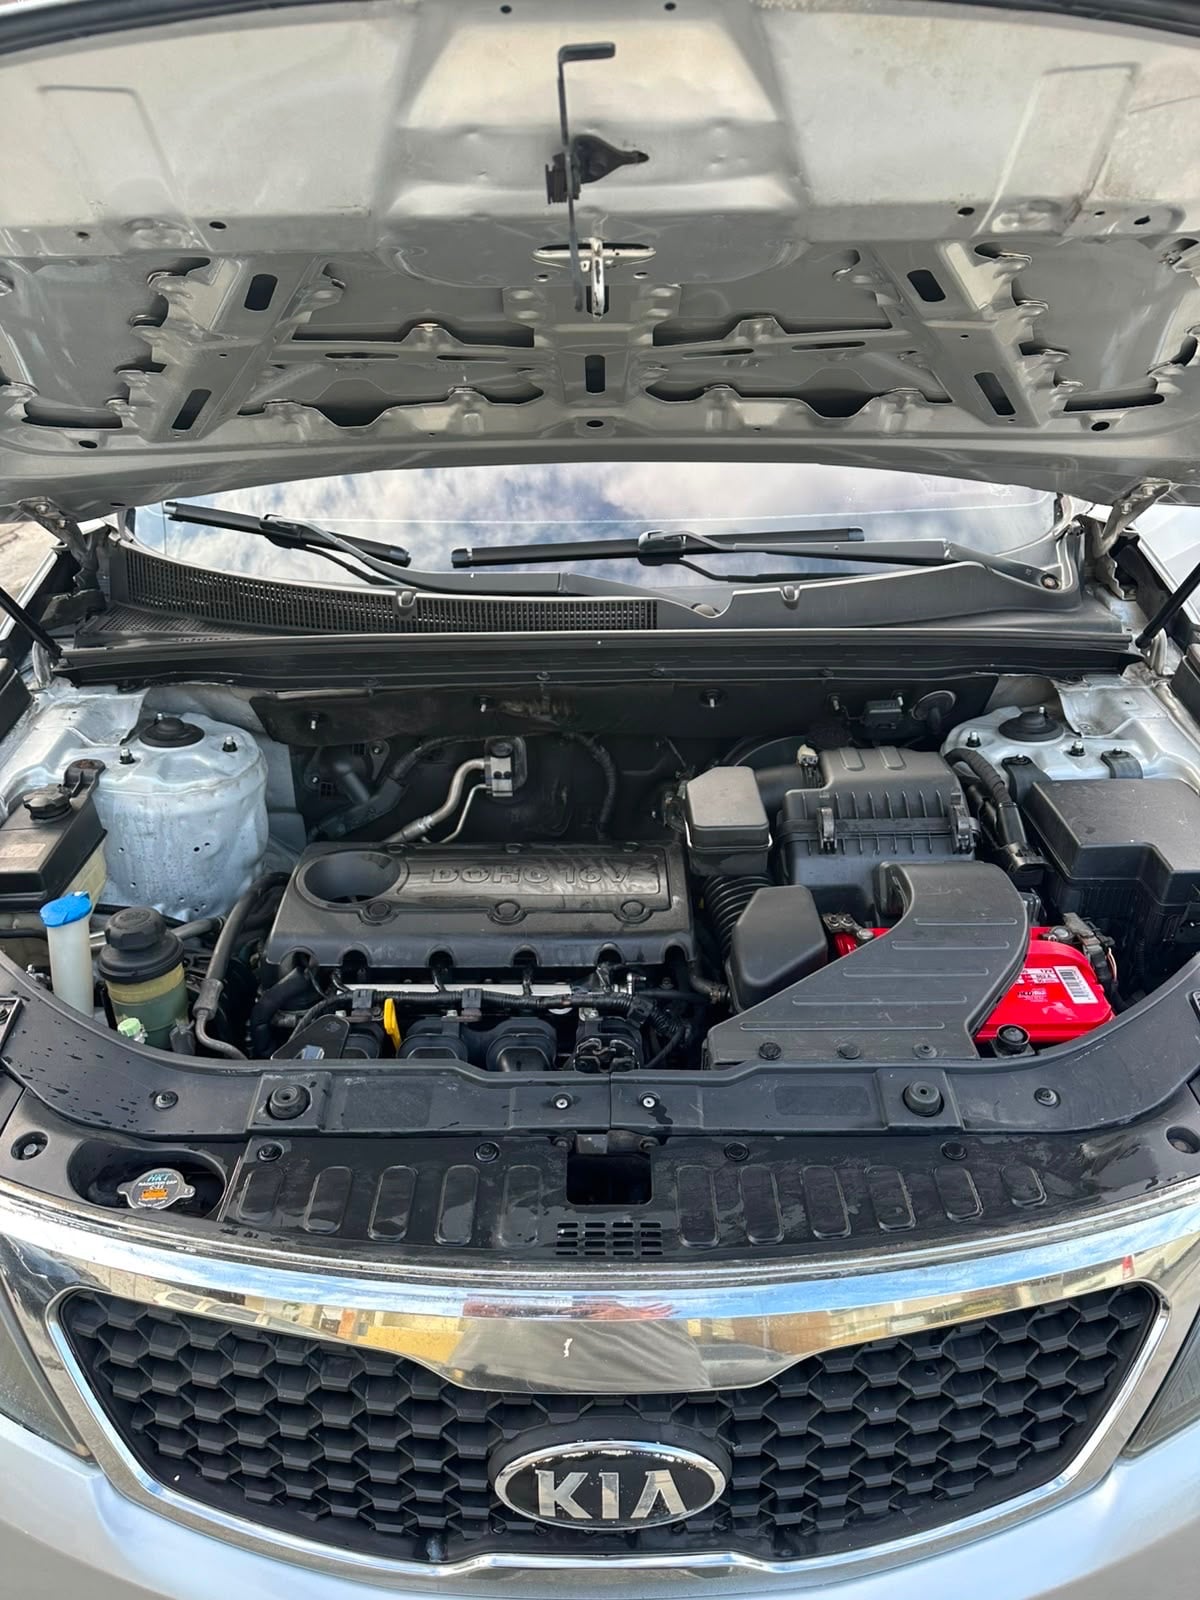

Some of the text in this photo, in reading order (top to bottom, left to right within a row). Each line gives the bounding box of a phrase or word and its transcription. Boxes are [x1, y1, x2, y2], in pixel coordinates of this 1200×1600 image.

[431, 865, 631, 884] DOHC 16V
[535, 1469, 688, 1520] KIA
